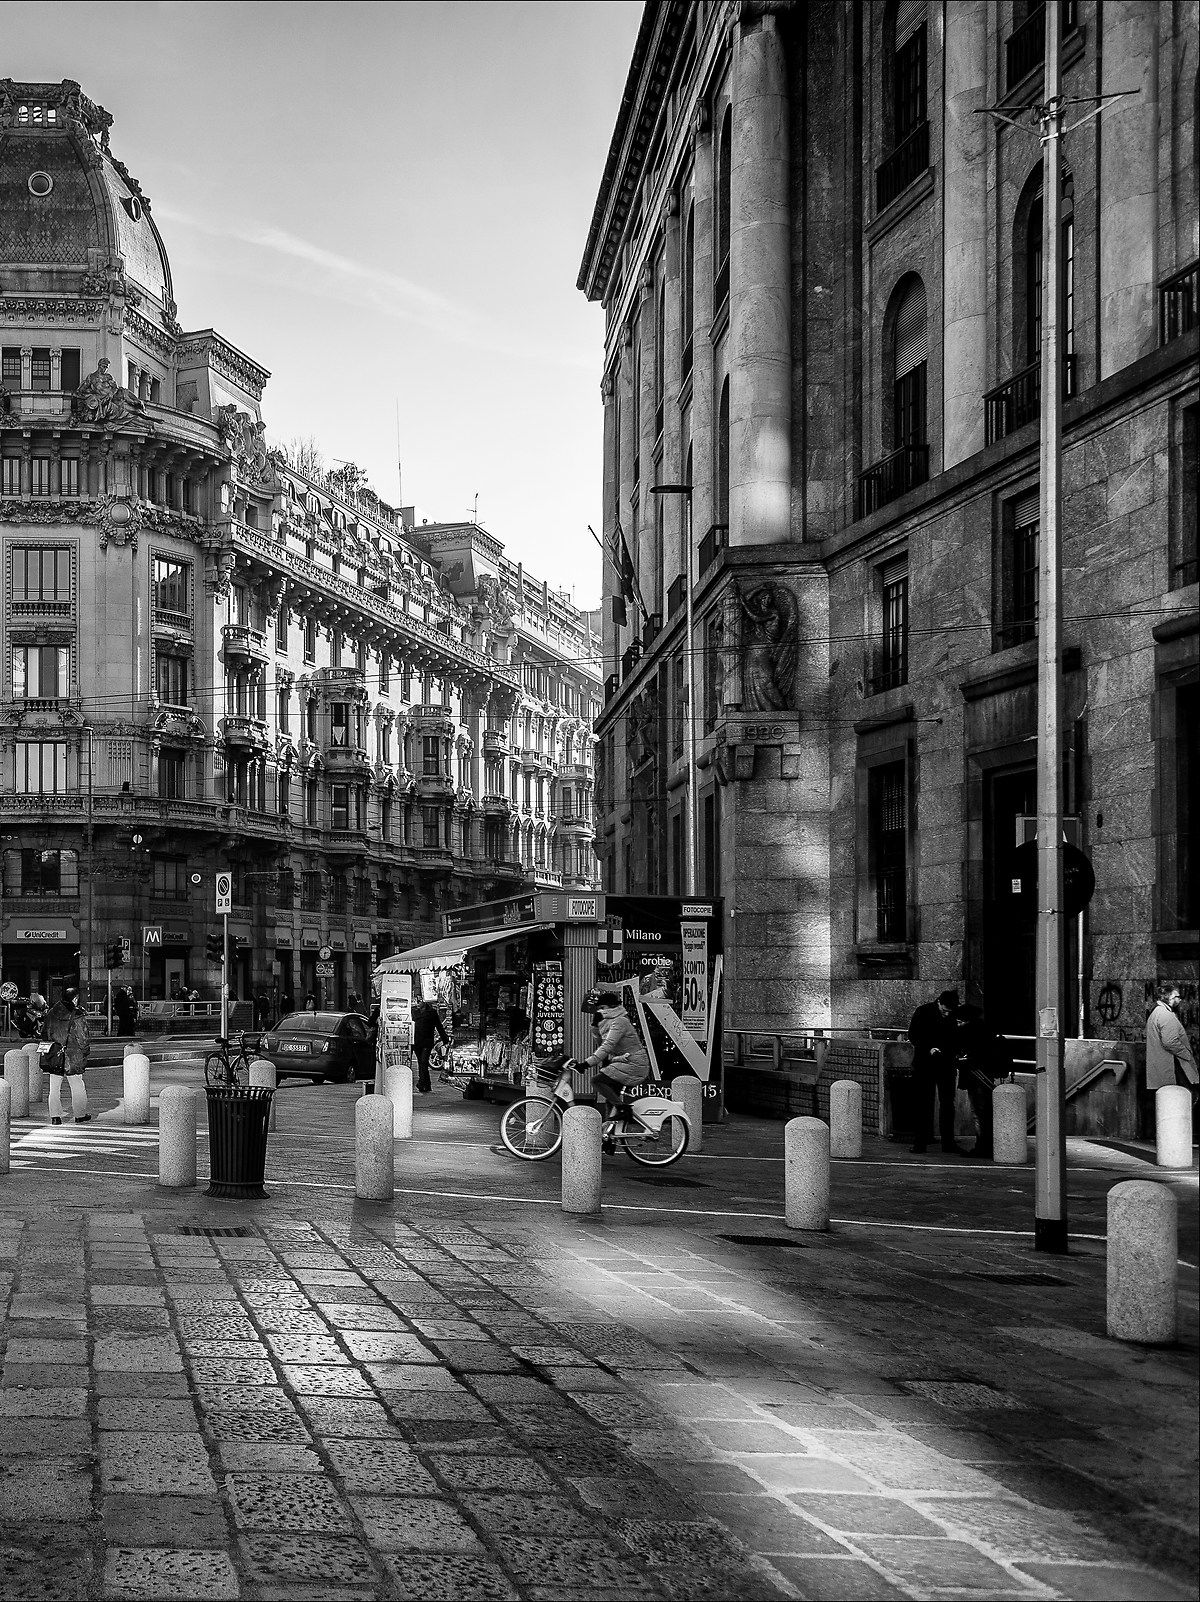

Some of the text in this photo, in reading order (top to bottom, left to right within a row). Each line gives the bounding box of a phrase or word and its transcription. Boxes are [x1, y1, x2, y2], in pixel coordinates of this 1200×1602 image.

[572, 900, 594, 915] FOTOCOPIE
[683, 906, 712, 914] FOTOCOPIE
[626, 929, 662, 941] Milano
[641, 956, 671, 966] orobie
[683, 960, 705, 975] SCONTO
[683, 976, 706, 1012] 50%
[631, 1083, 717, 1099] di Exp 15
